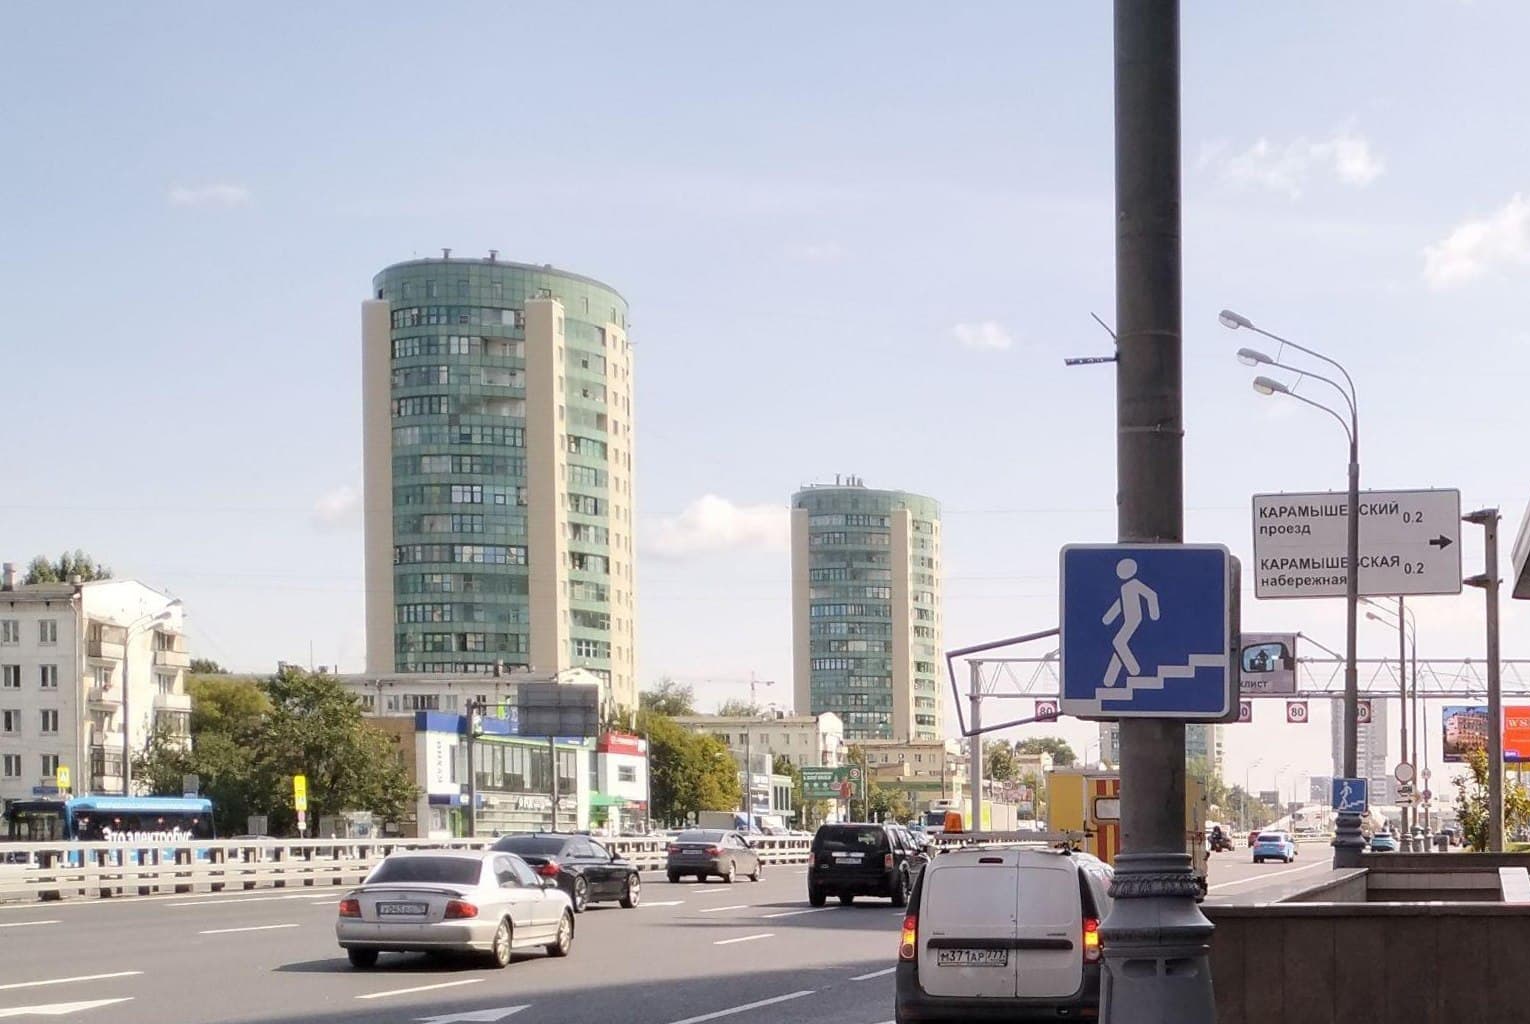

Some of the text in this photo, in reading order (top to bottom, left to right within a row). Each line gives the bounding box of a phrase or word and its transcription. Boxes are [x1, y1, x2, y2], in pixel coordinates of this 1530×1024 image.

[1259, 500, 1423, 524] КАРАМЫШЕСКИЙ 0.2
[1259, 524, 1312, 536] проезд
[1260, 555, 1425, 575] КАРАМЫШЕСКАЯ 0.2
[1261, 575, 1348, 588] набережная
[1040, 706, 1053, 717] 80
[1291, 707, 1304, 717] 80
